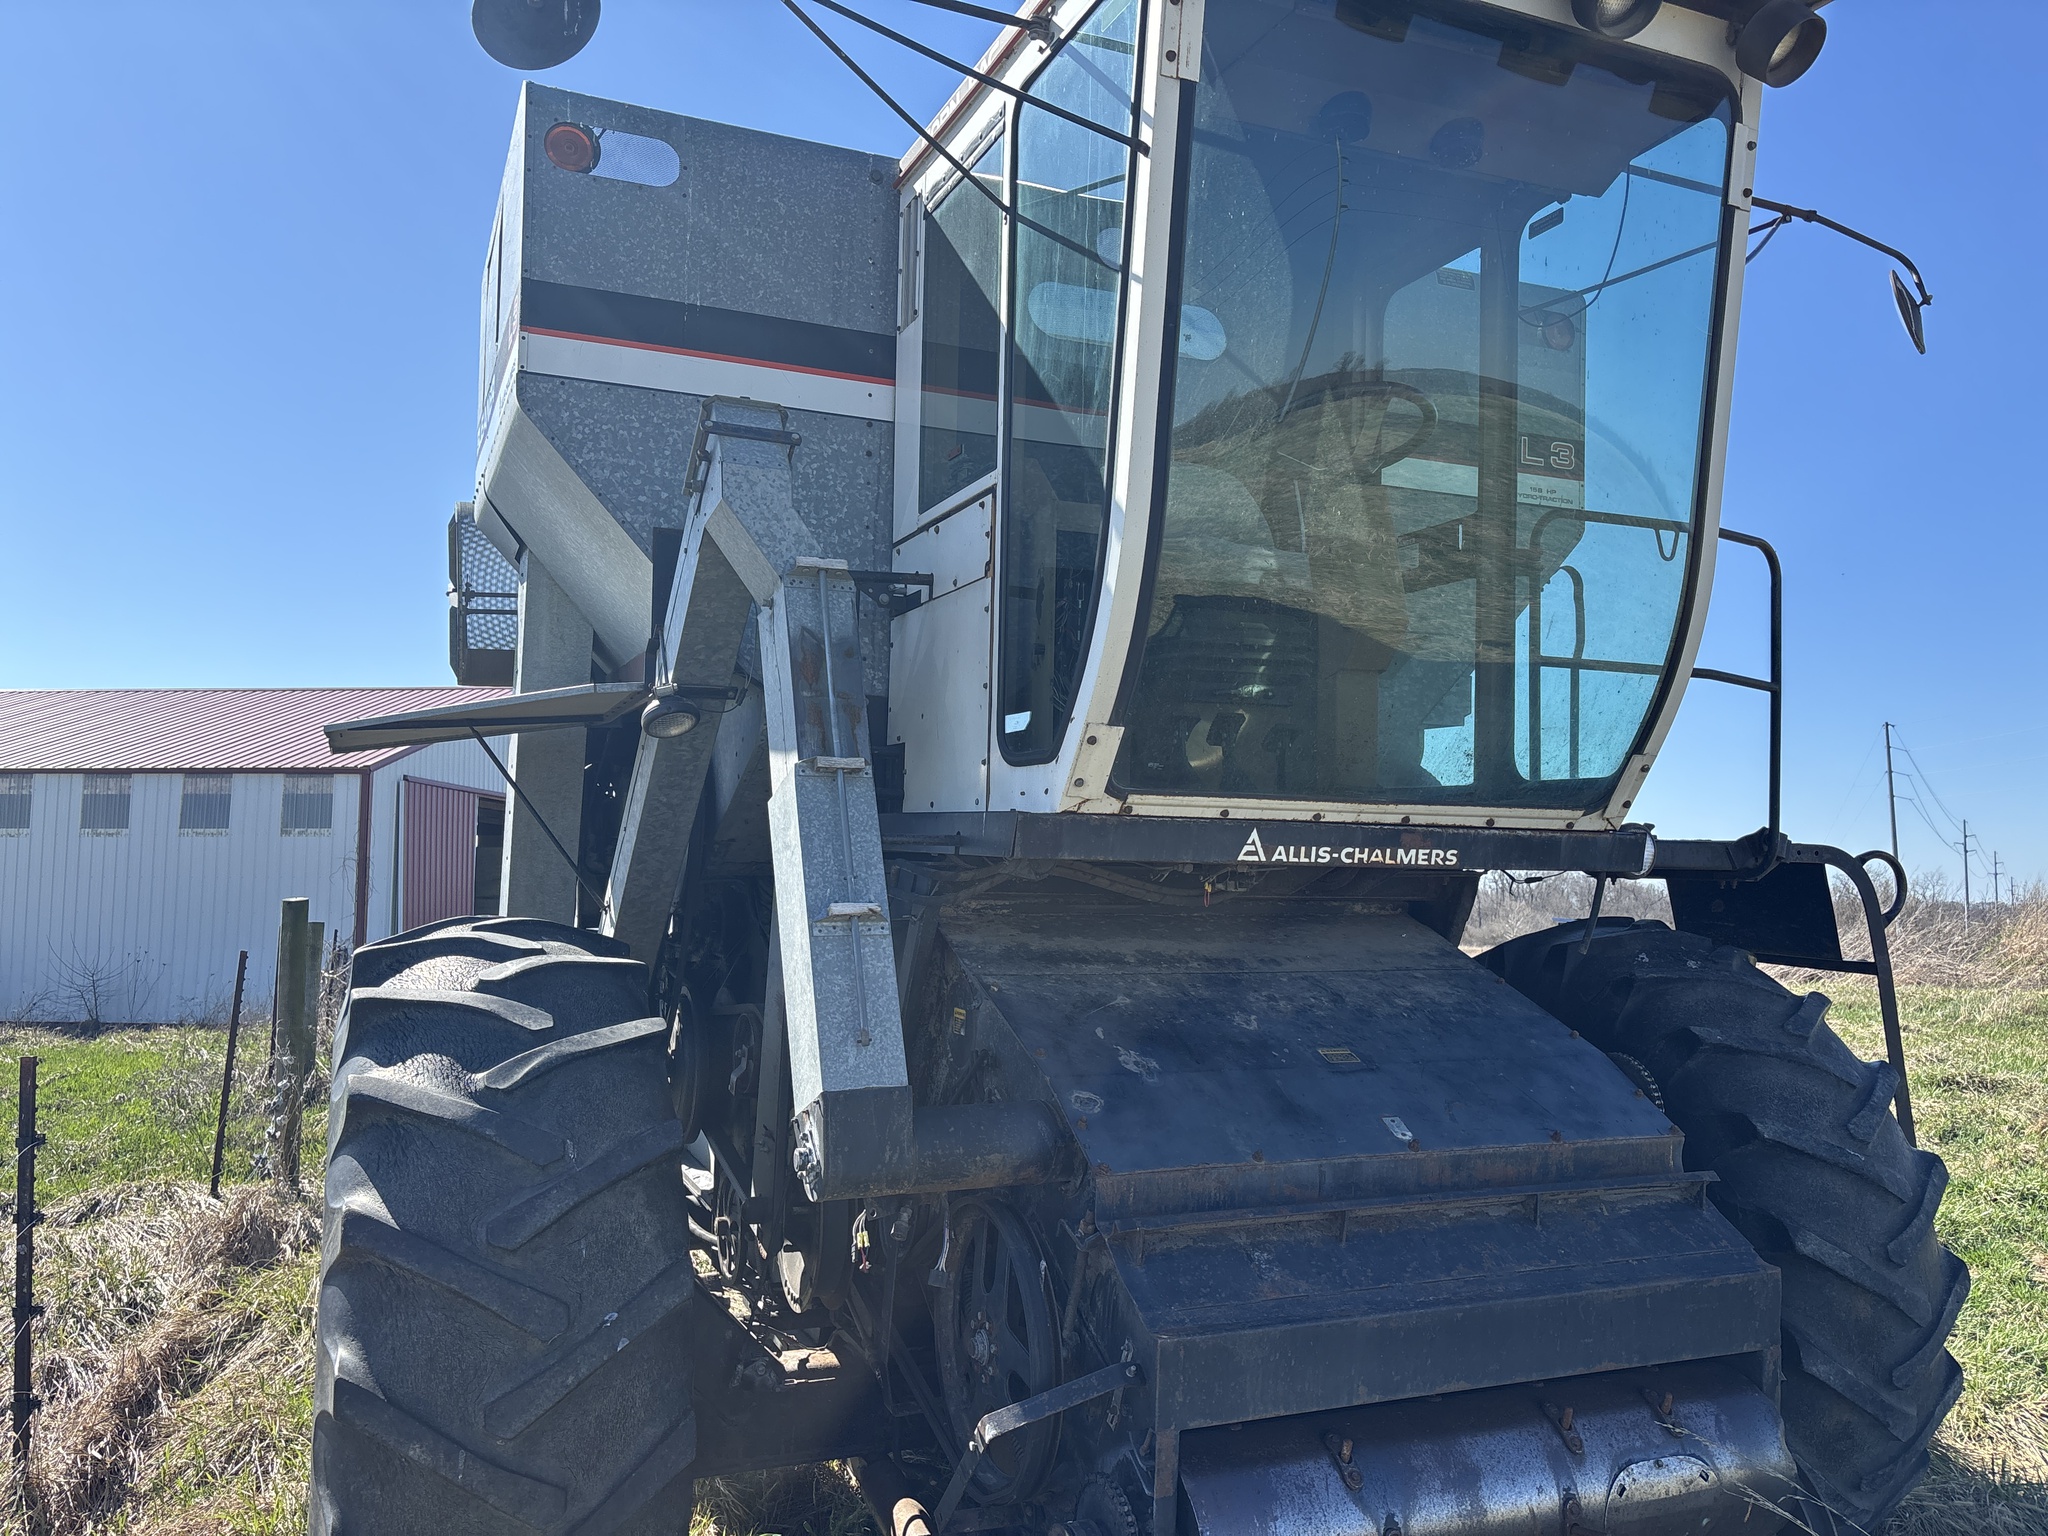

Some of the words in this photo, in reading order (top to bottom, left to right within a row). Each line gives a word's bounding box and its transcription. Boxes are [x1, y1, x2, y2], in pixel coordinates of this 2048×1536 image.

[1521, 436, 1575, 470] L3
[1517, 492, 1574, 505] YDRO-TRACTION
[1271, 845, 1459, 867] ALLIS-CHALMERS
